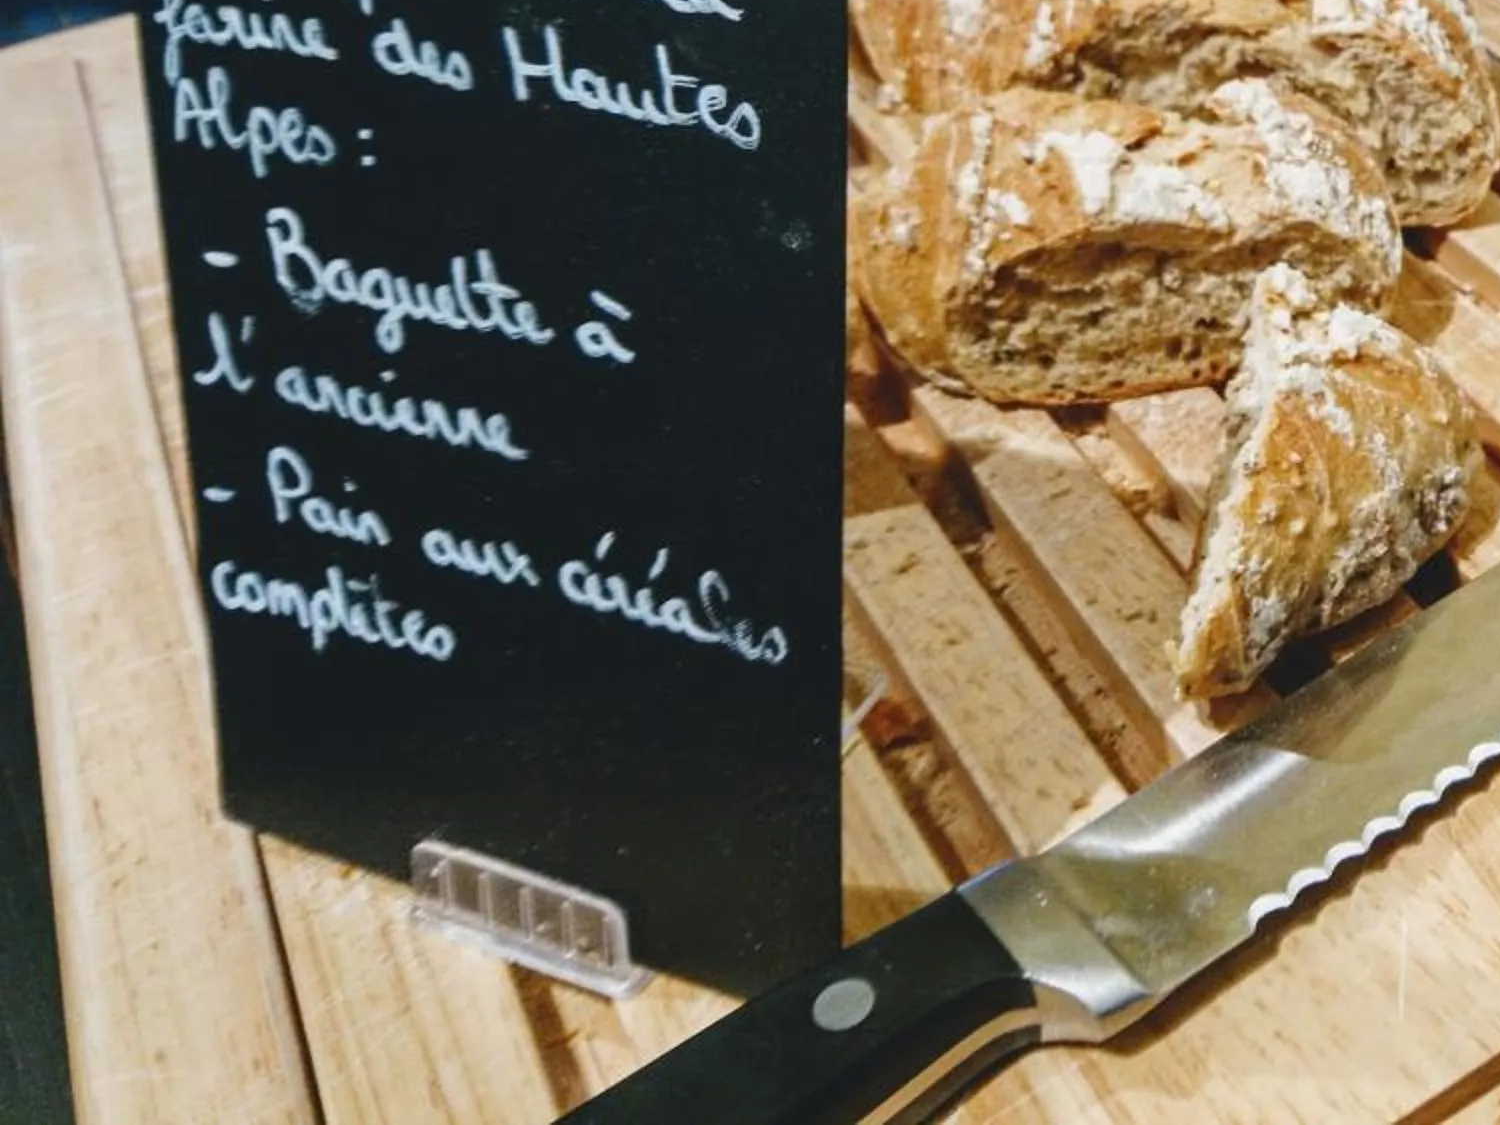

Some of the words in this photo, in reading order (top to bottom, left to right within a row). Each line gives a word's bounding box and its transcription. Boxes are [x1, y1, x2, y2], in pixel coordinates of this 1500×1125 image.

[371, 17, 474, 92] des
[501, 23, 762, 150] Hautes
[265, 206, 556, 354] Baguette
[574, 290, 637, 364] à
[210, 560, 456, 662] complètes
[266, 445, 392, 547] Pain
[420, 528, 541, 587] aux
[557, 530, 789, 664] céréales
